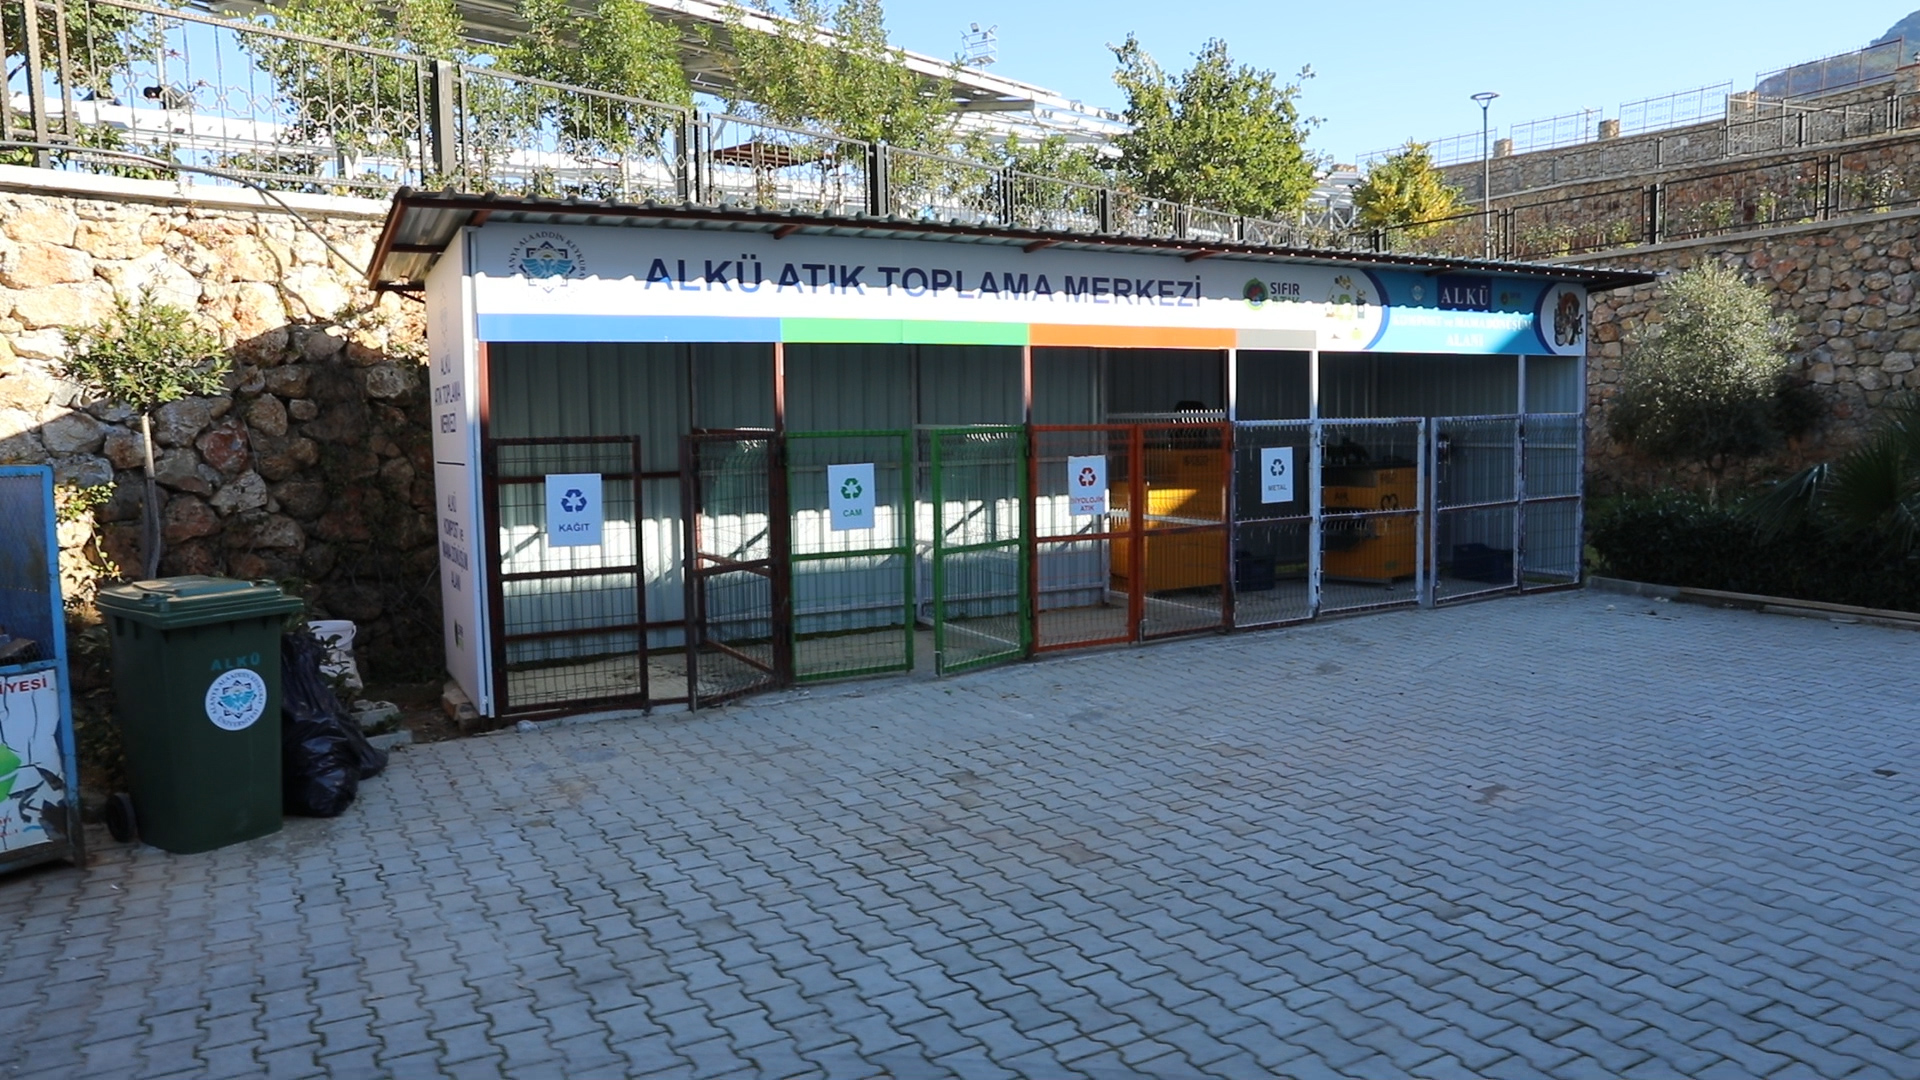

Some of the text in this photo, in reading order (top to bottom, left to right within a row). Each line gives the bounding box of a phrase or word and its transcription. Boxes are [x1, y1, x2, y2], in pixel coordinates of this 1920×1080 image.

[519, 231, 565, 247] ALAADDİN
[644, 253, 1202, 307] ALKÜ ATIK TOPLAMA MERKEZİ
[1270, 282, 1300, 296] SIFIR
[1440, 285, 1489, 306] ALKÜ
[842, 509, 863, 517] CAM
[558, 522, 591, 532] KAĞIT
